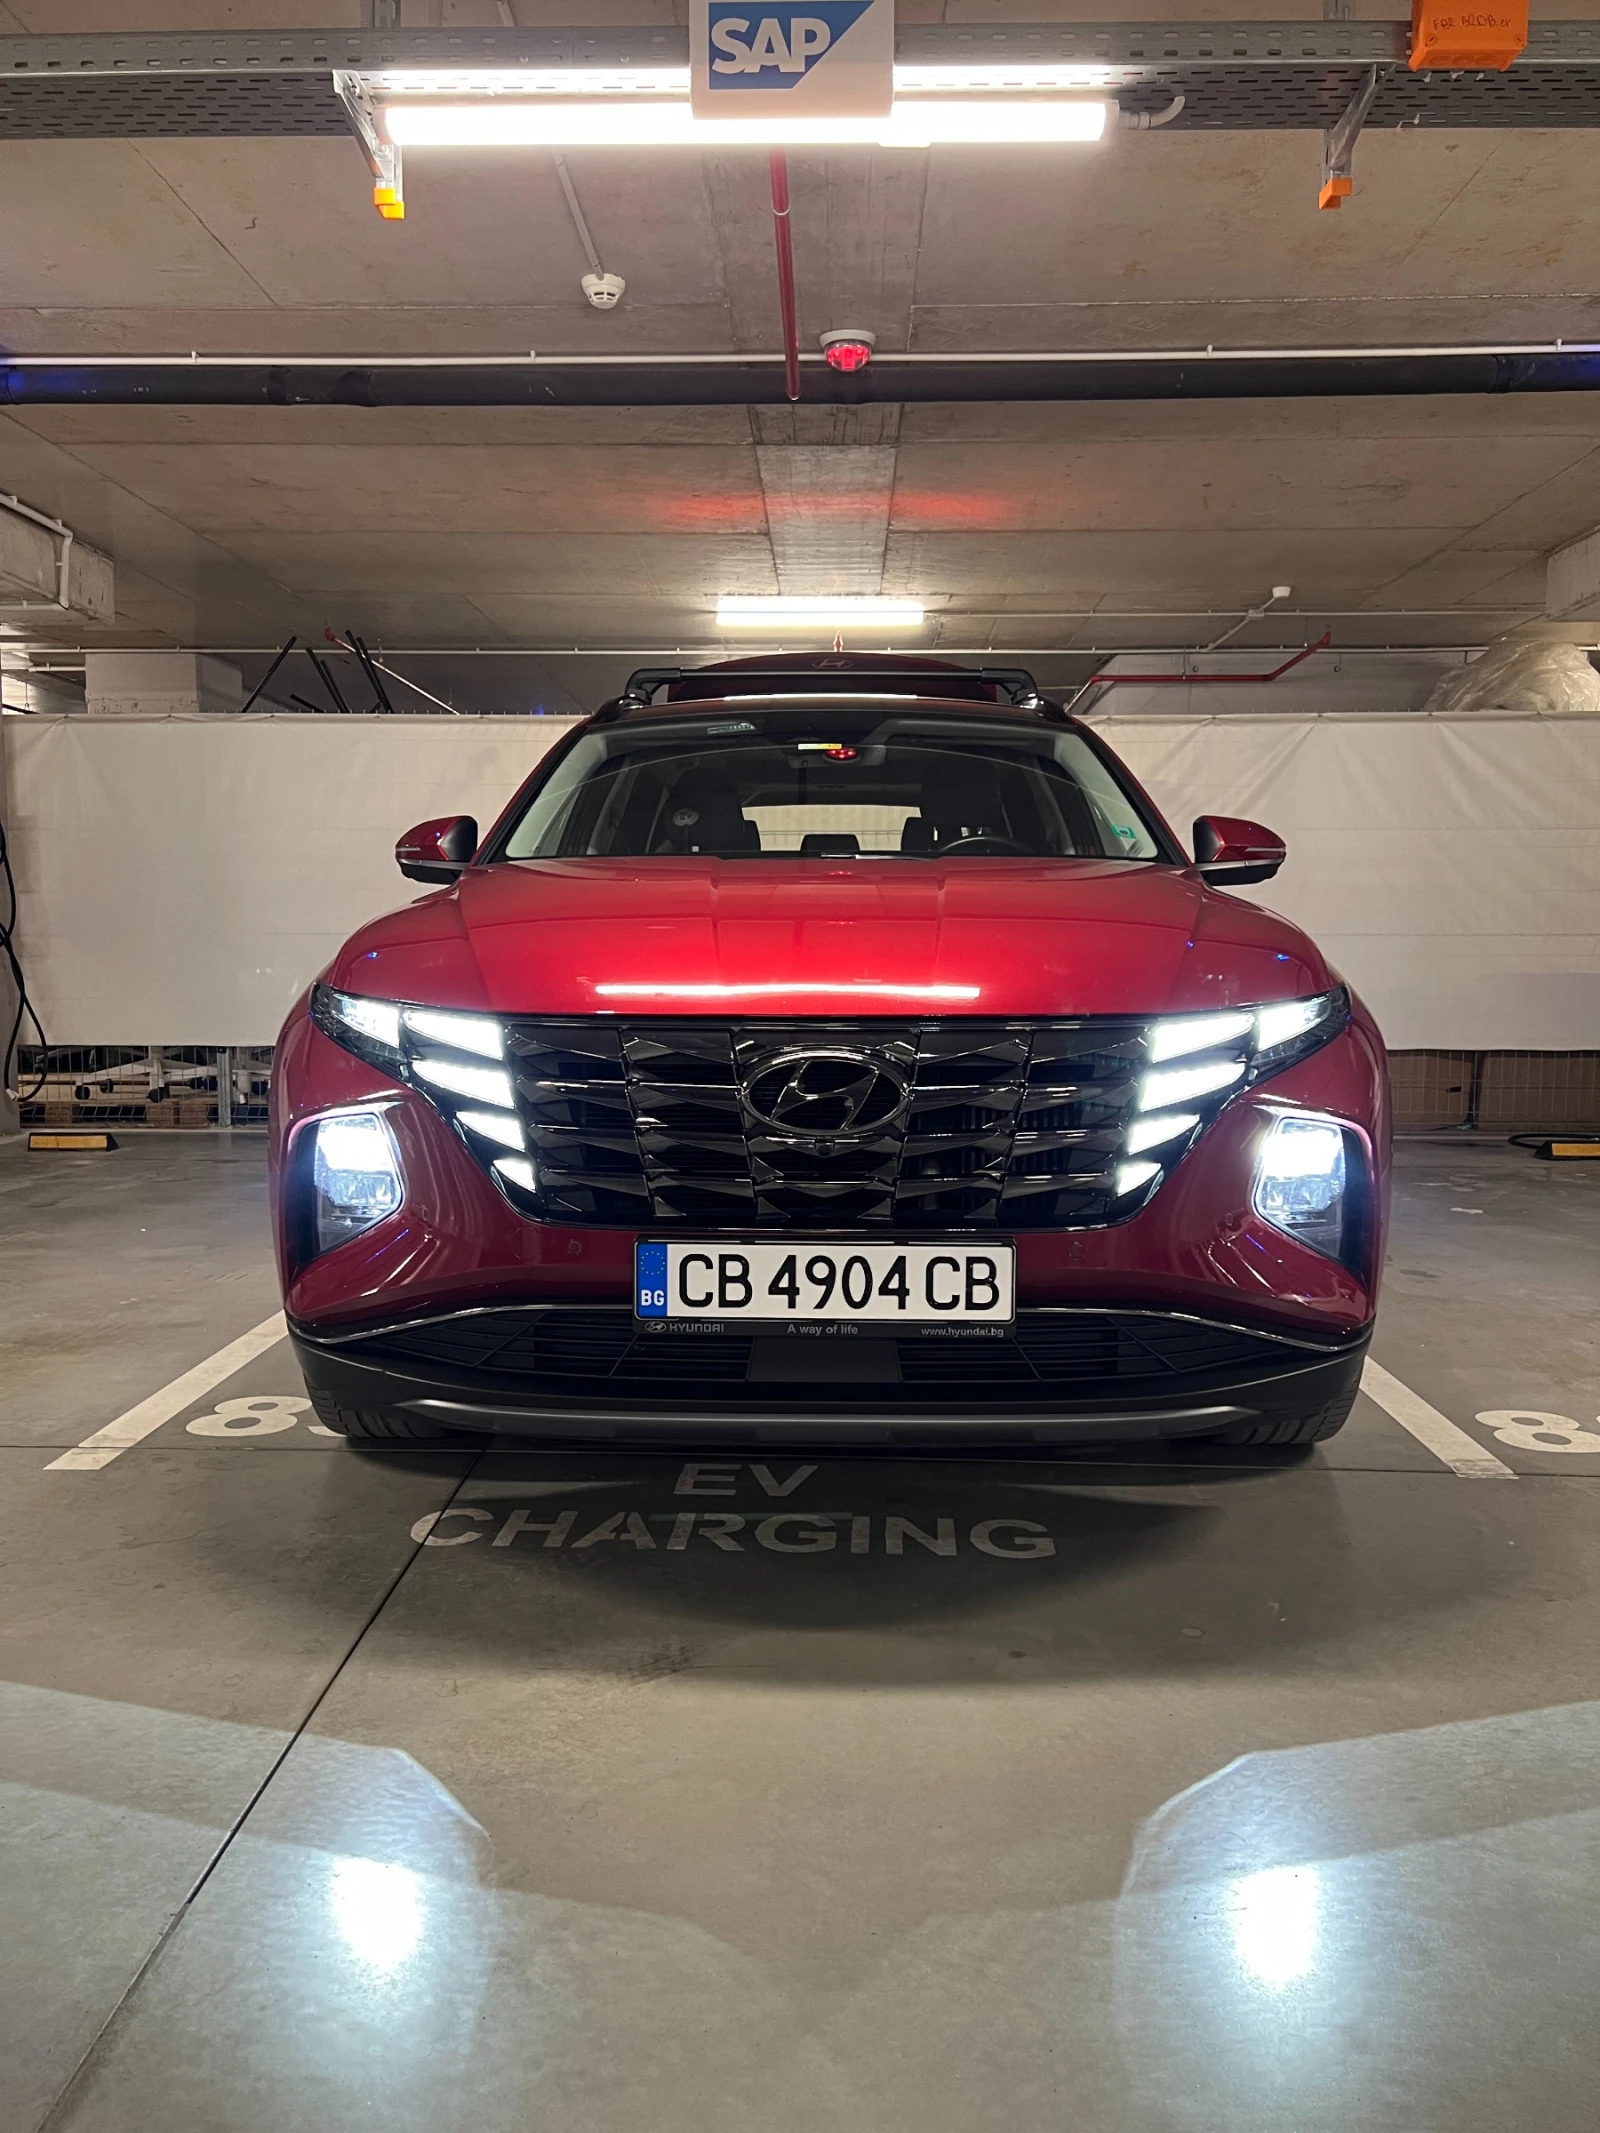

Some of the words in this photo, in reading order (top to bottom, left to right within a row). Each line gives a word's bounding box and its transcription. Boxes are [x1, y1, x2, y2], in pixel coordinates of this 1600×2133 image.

[711, 18, 831, 74] SAP
[641, 1289, 665, 1307] BG
[679, 1254, 753, 1308] CB
[768, 1255, 910, 1309] 4904
[925, 1256, 1000, 1310] CB
[669, 1323, 725, 1333] HYUNDAI
[787, 1324, 797, 1334] A
[799, 1325, 823, 1336] way
[825, 1324, 839, 1334] of
[841, 1324, 859, 1335] life
[921, 1327, 1004, 1338] www.hyundai.bg
[185, 1395, 347, 1437] 8
[673, 1463, 819, 1497] EV
[410, 1508, 1056, 1559] CHARGING
